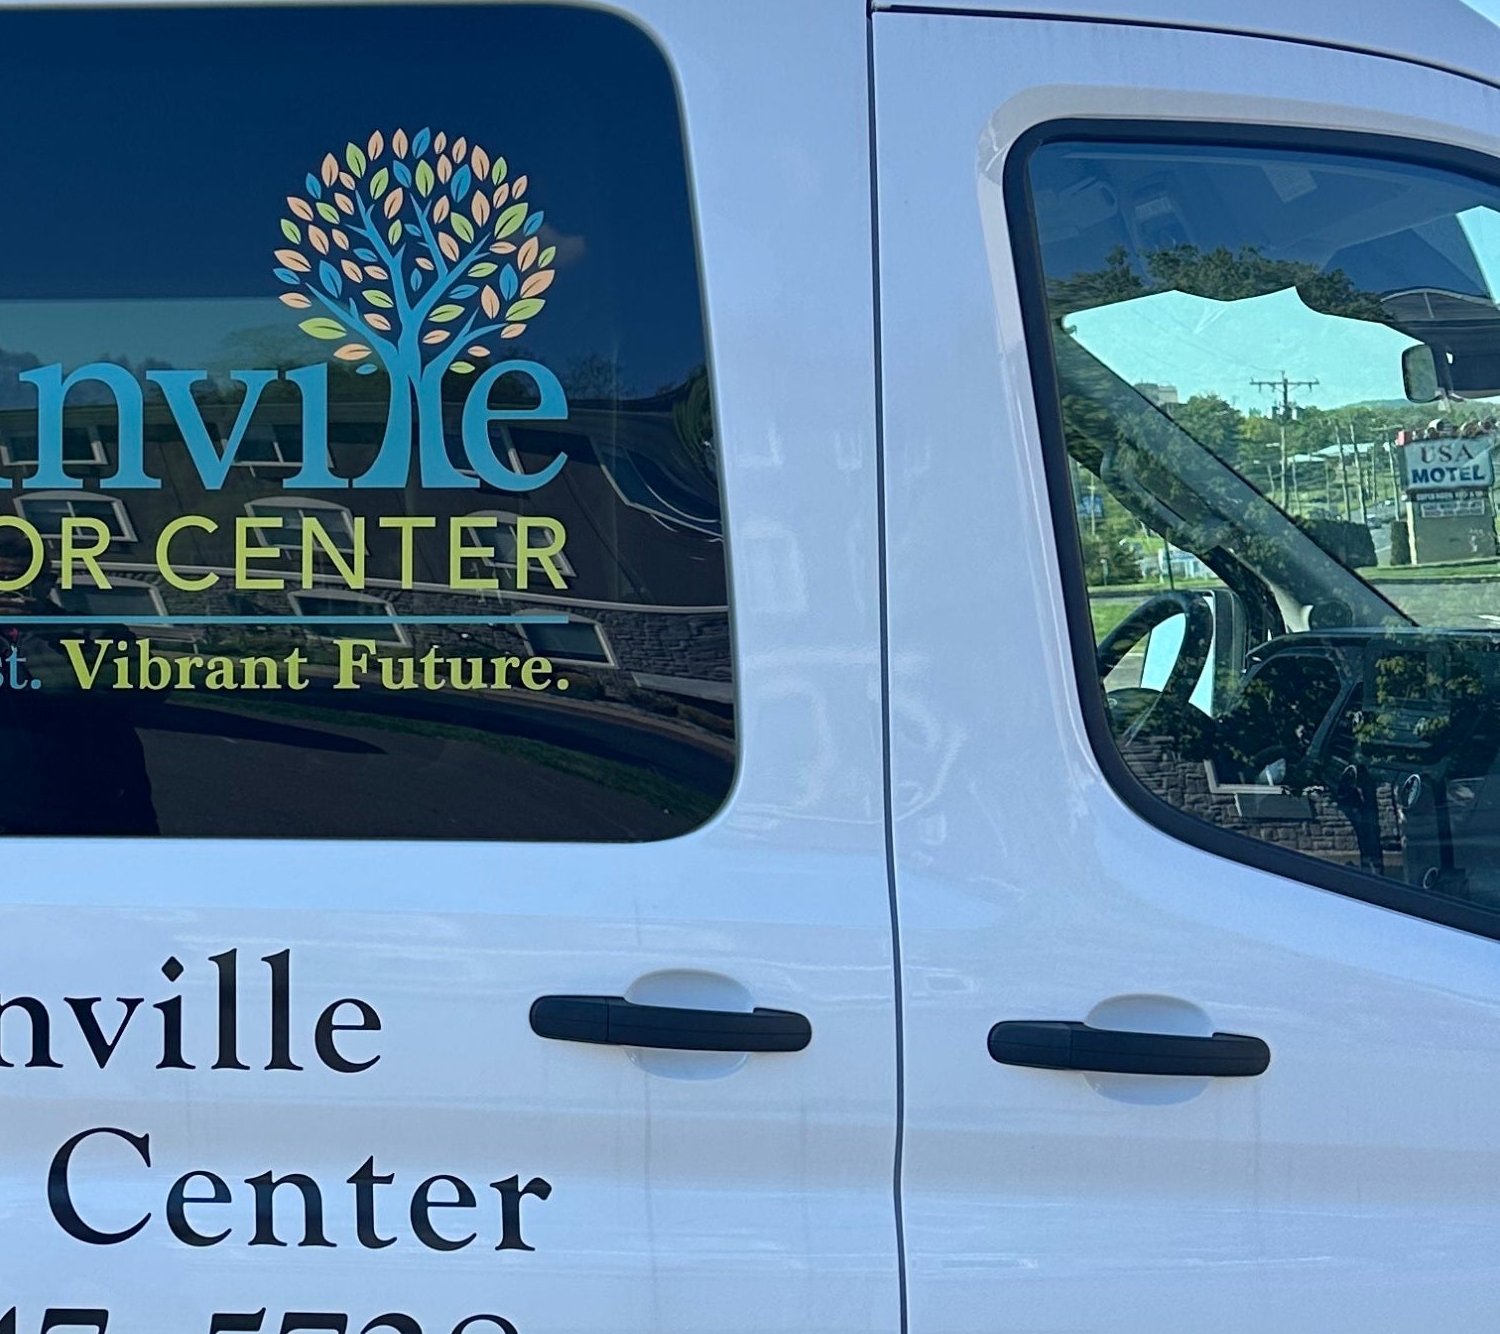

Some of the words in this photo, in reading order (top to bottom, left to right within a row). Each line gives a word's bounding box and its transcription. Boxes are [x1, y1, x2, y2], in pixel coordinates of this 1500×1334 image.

[1411, 464, 1485, 484] MOTEL
[1420, 444, 1474, 464] USA
[155, 514, 568, 592] CENTER
[60, 637, 311, 691] Vibrant
[332, 638, 571, 692] Future.
[46, 1126, 553, 1252] Center
